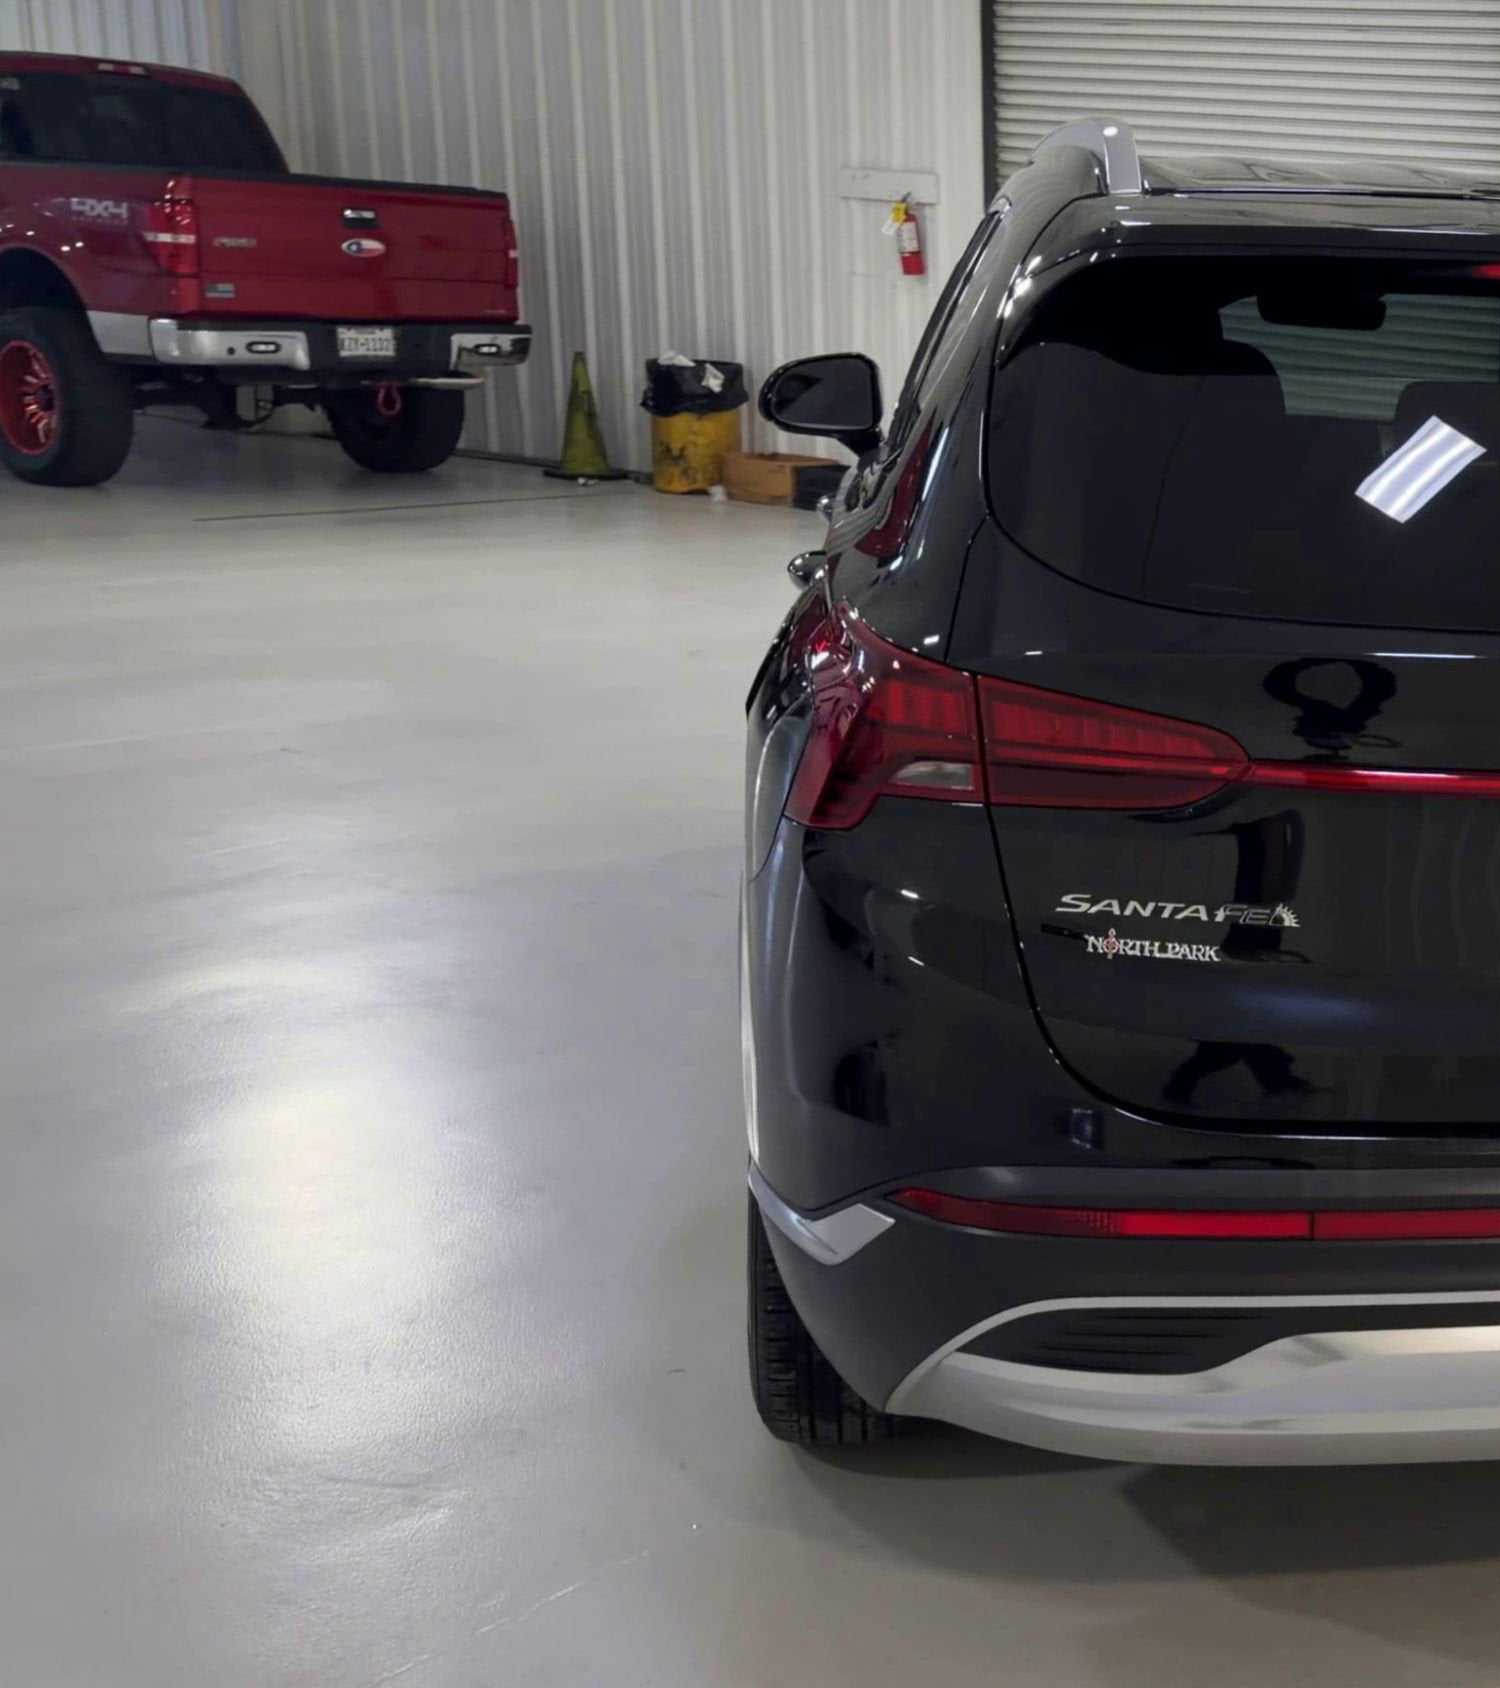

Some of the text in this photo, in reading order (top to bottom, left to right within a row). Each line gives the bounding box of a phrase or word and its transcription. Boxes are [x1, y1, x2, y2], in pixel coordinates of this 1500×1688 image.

[1055, 894, 1210, 922] SANTA
[1085, 932, 1222, 963] NORTH PARK
